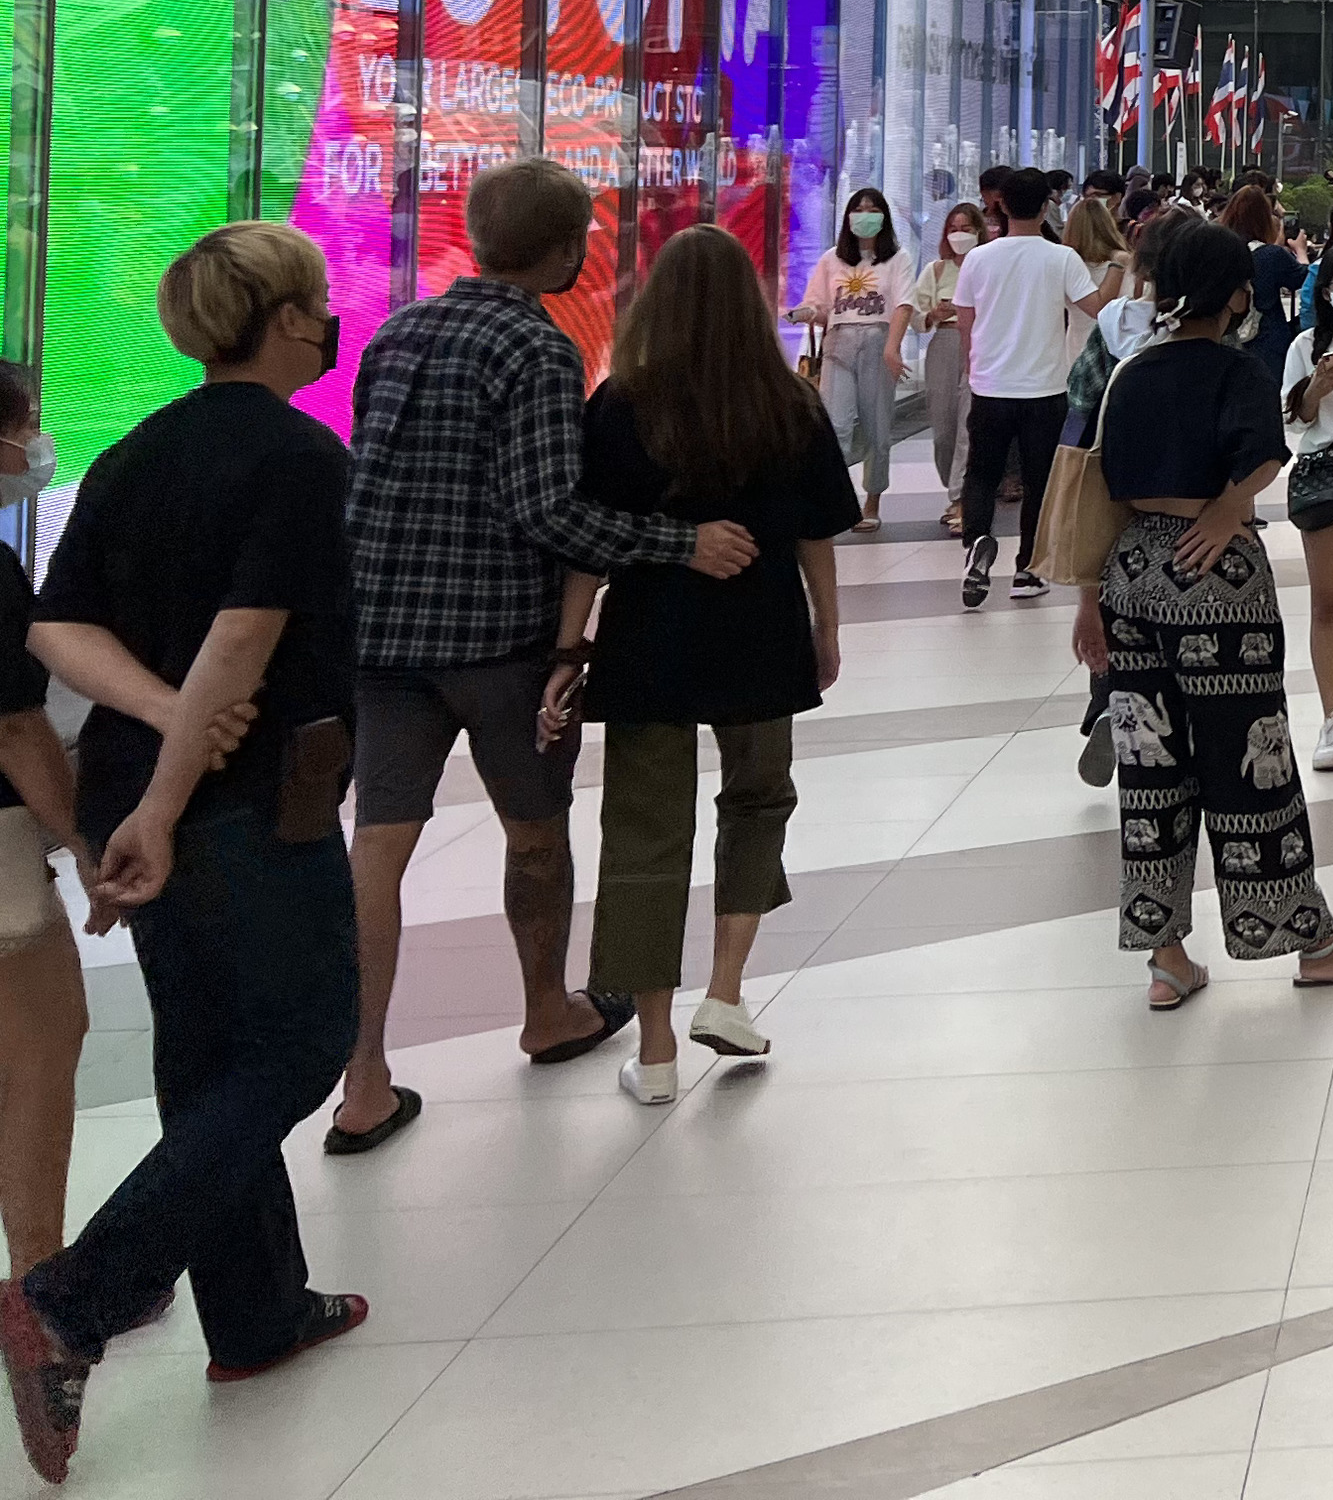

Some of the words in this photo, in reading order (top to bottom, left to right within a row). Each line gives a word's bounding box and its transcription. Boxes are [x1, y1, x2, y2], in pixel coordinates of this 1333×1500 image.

[359, 53, 434, 106] YOR
[441, 60, 521, 113] LARGE
[324, 141, 383, 194] FOR
[638, 146, 683, 188] ETTER
